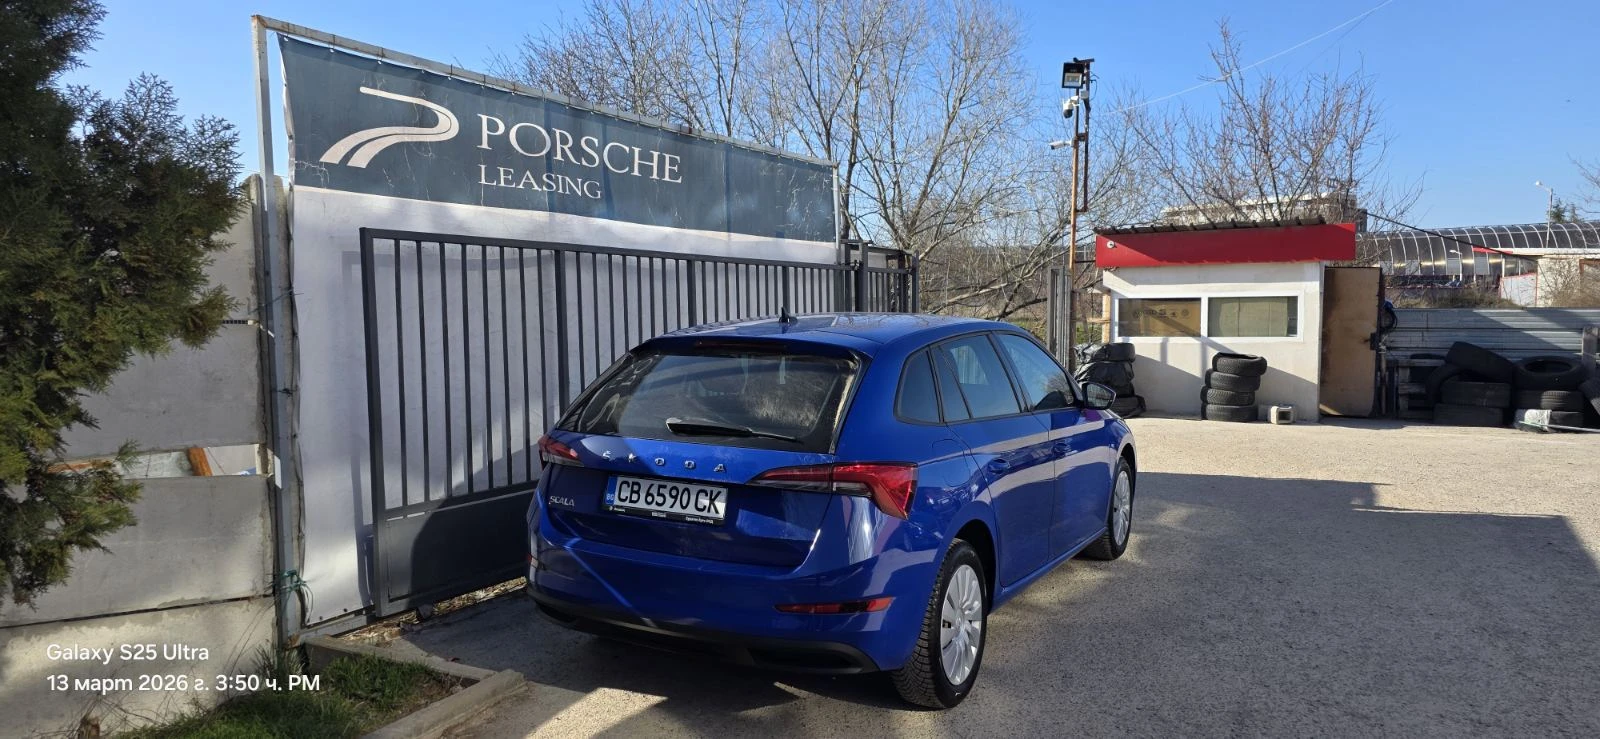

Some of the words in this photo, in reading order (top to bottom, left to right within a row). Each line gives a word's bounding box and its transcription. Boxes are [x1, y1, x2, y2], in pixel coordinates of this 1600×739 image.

[476, 113, 683, 184] PORSCHE
[478, 164, 602, 199] LEASING
[550, 495, 575, 507] SCALA
[617, 480, 641, 504] CB
[644, 483, 691, 510] 6590
[694, 489, 722, 514] CK
